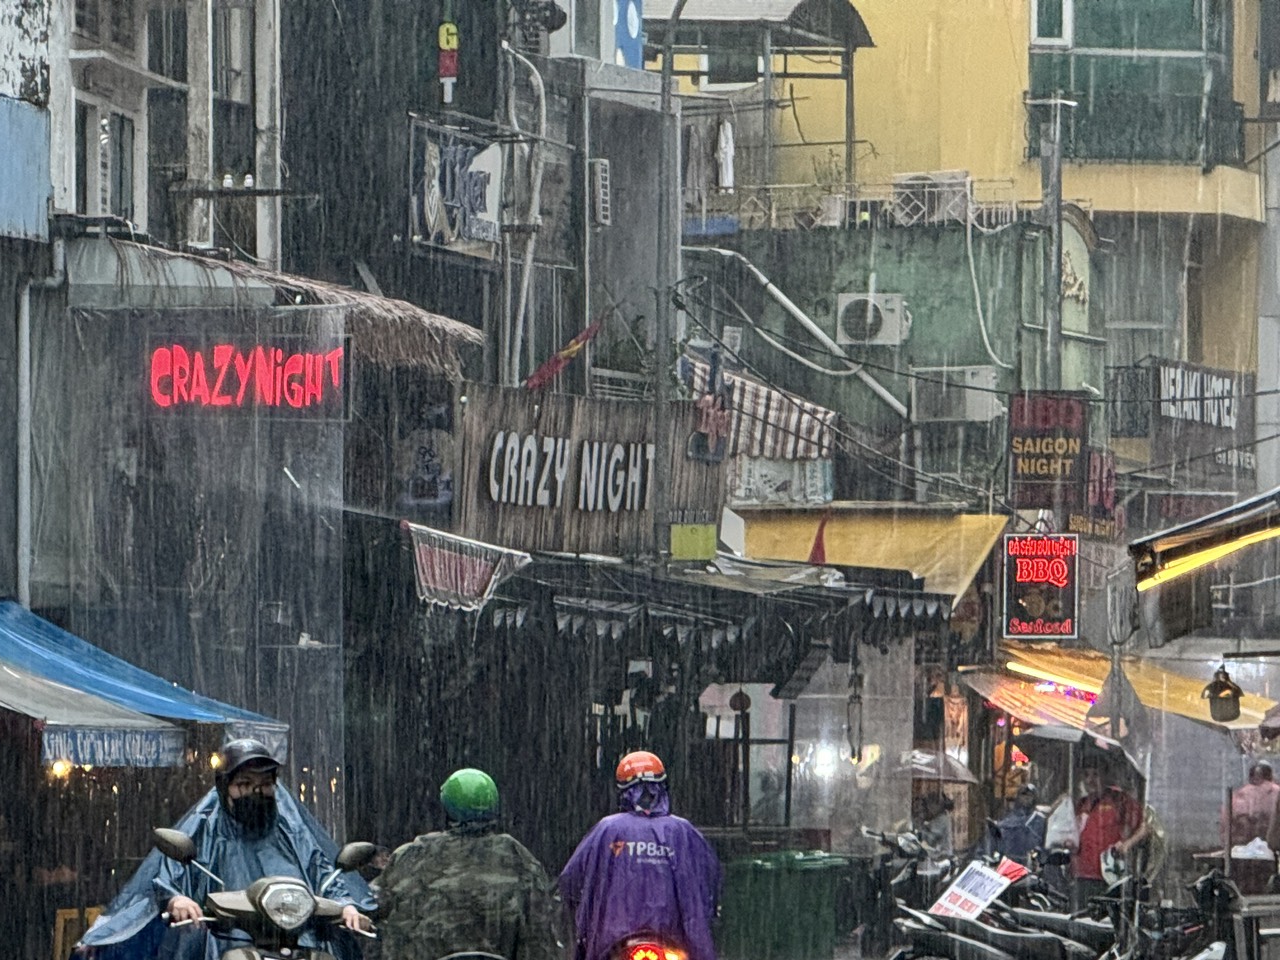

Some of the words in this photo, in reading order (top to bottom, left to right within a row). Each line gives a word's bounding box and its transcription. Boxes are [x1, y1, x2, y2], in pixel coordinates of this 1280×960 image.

[1012, 437, 1081, 454] SAIGON
[489, 430, 570, 508] CRAZY
[578, 440, 655, 512] NIGHT
[1017, 458, 1074, 477] NIGHT
[1016, 558, 1068, 587] BBQ
